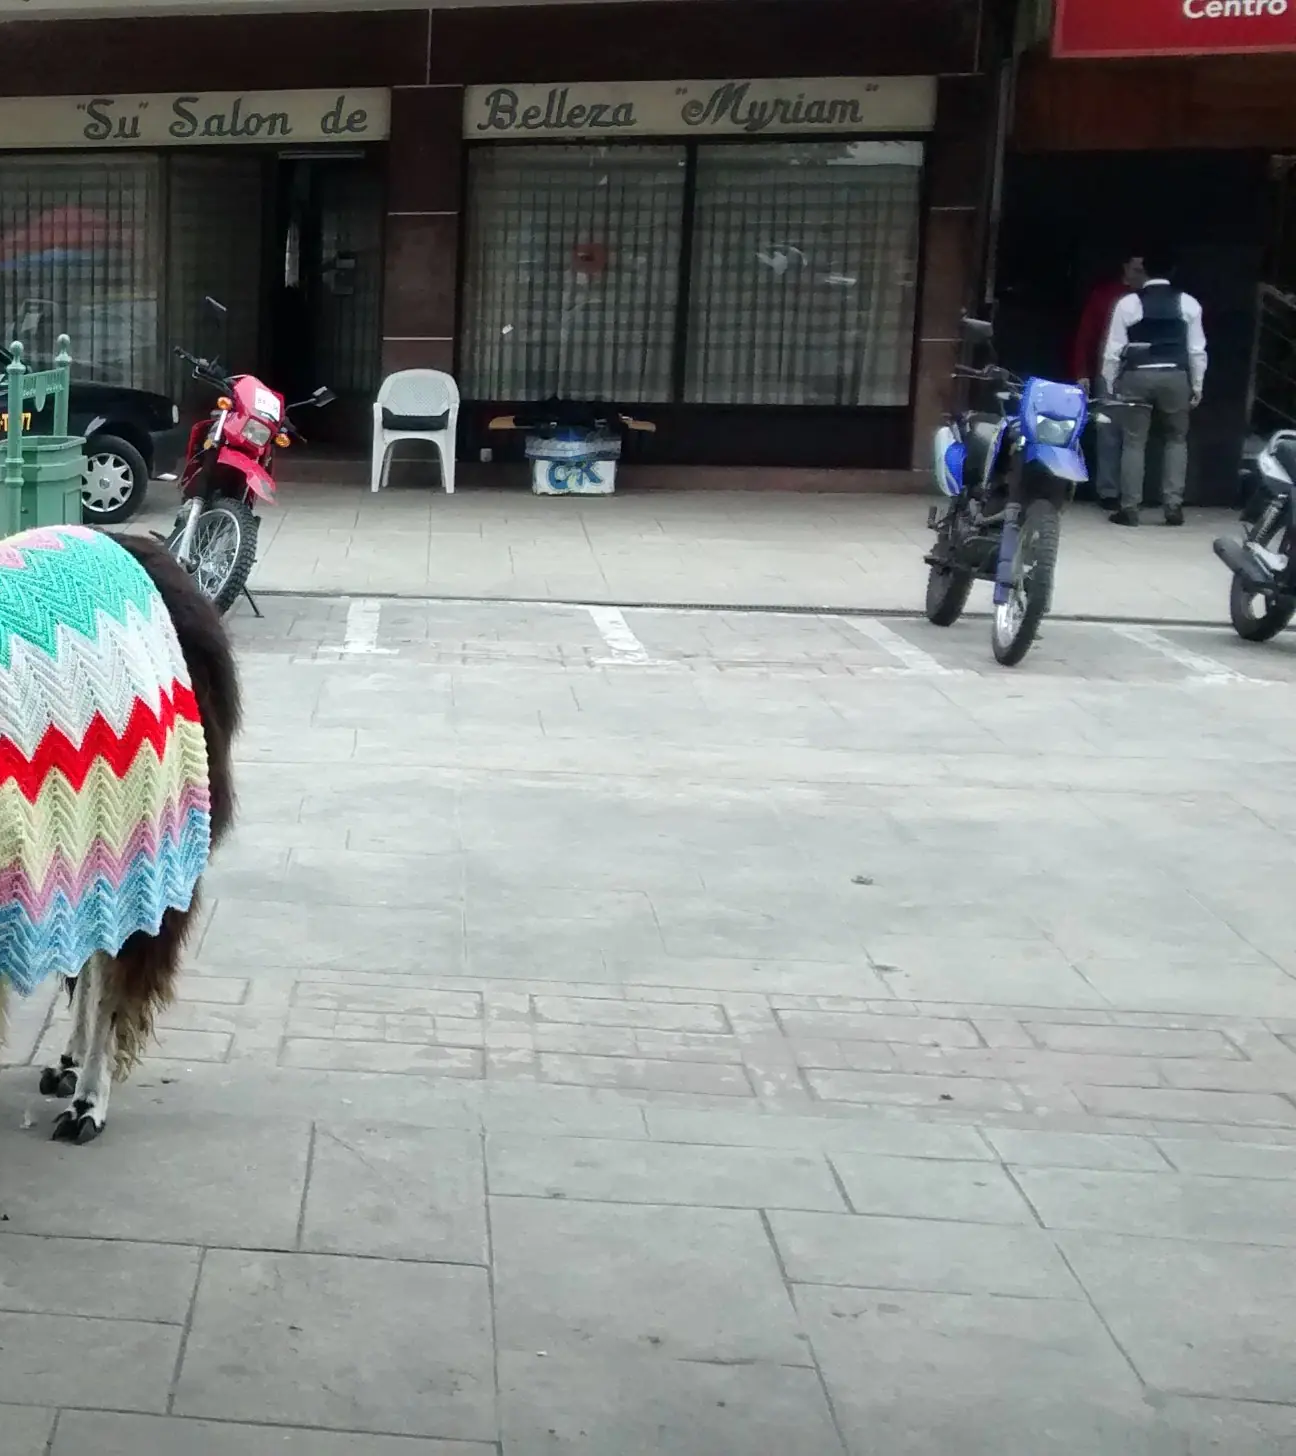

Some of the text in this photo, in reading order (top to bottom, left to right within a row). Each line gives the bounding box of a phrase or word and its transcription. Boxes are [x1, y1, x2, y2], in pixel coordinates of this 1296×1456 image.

[1183, 0, 1288, 19] Centro
[169, 96, 293, 138] Salon
[320, 95, 368, 135] de
[477, 88, 637, 131] Belleza
